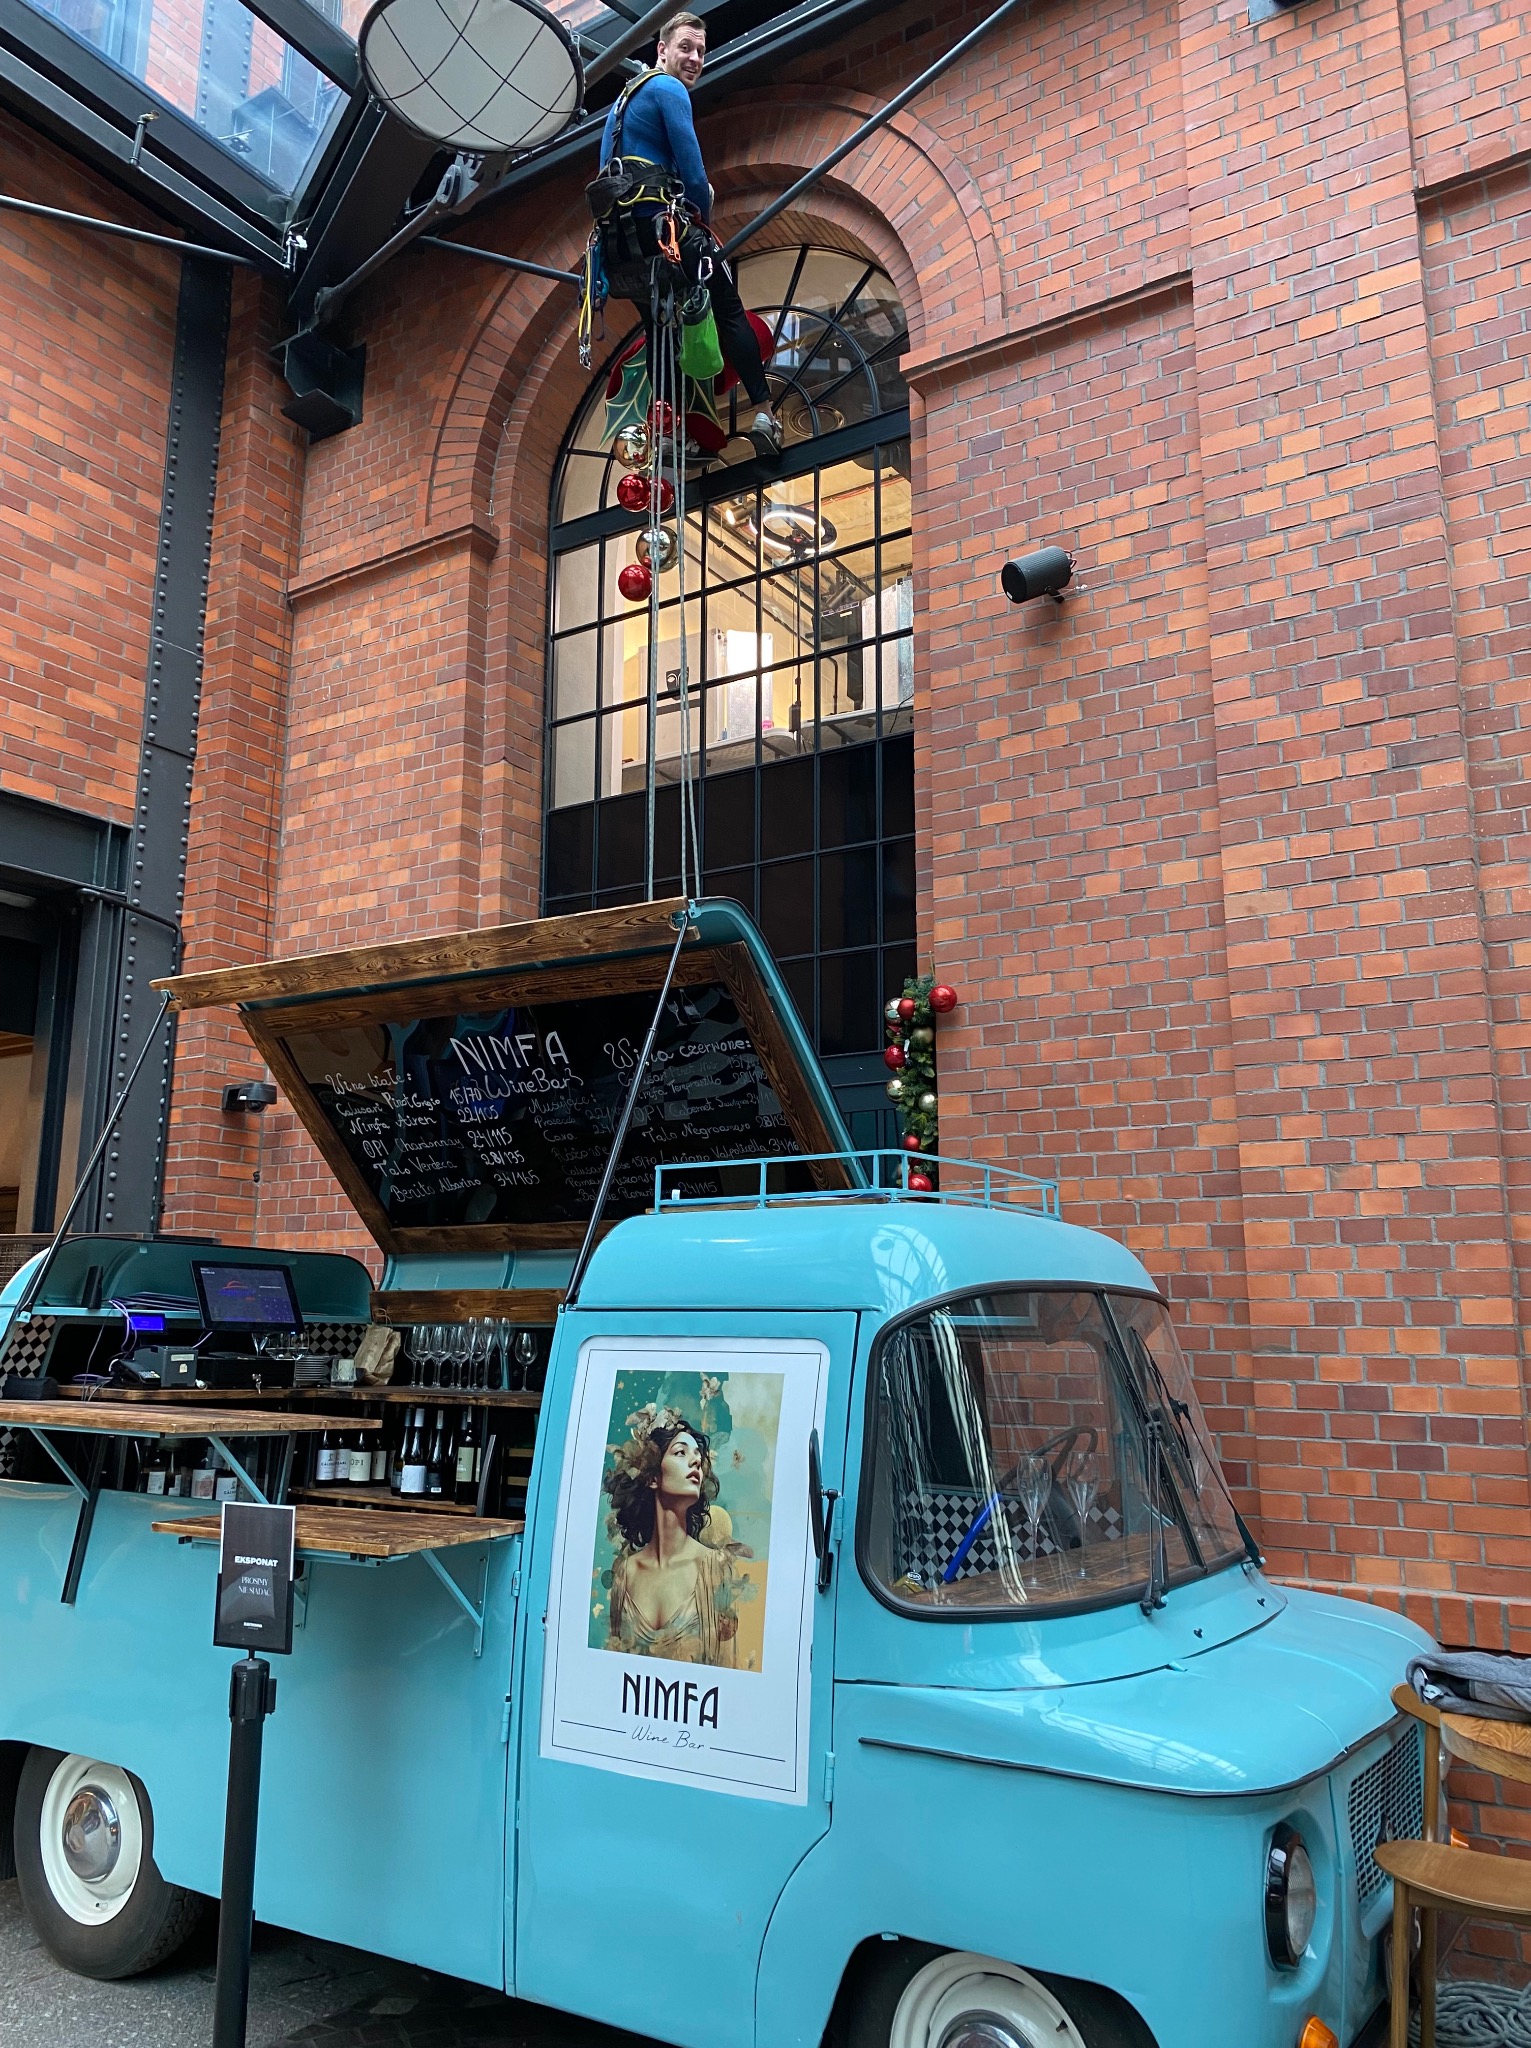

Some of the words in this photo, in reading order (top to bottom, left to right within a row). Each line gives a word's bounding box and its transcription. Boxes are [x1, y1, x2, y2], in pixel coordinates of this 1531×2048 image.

[450, 1031, 569, 1075] NIMFA
[679, 1038, 752, 1057] czerwone:
[450, 1087, 482, 1106] 15/70
[668, 1098, 715, 1117] Cabernet
[351, 1118, 390, 1136] Nimfa
[395, 1114, 437, 1127] Airen
[457, 1105, 499, 1124] 22/105
[363, 1139, 389, 1159] OPI
[395, 1137, 465, 1154] Chardonnay
[467, 1126, 513, 1149] 24/115
[543, 1129, 578, 1143] Cava
[408, 1156, 457, 1174] Verdeca
[481, 1150, 525, 1167] 28/135
[494, 1170, 540, 1187] 34/165
[234, 1555, 278, 1567] EKSPONAT
[241, 1576, 269, 1586] PROSIMY
[622, 1671, 719, 1729] NIMFA
[631, 1723, 670, 1744] Wine
[672, 1729, 705, 1750] Bar
